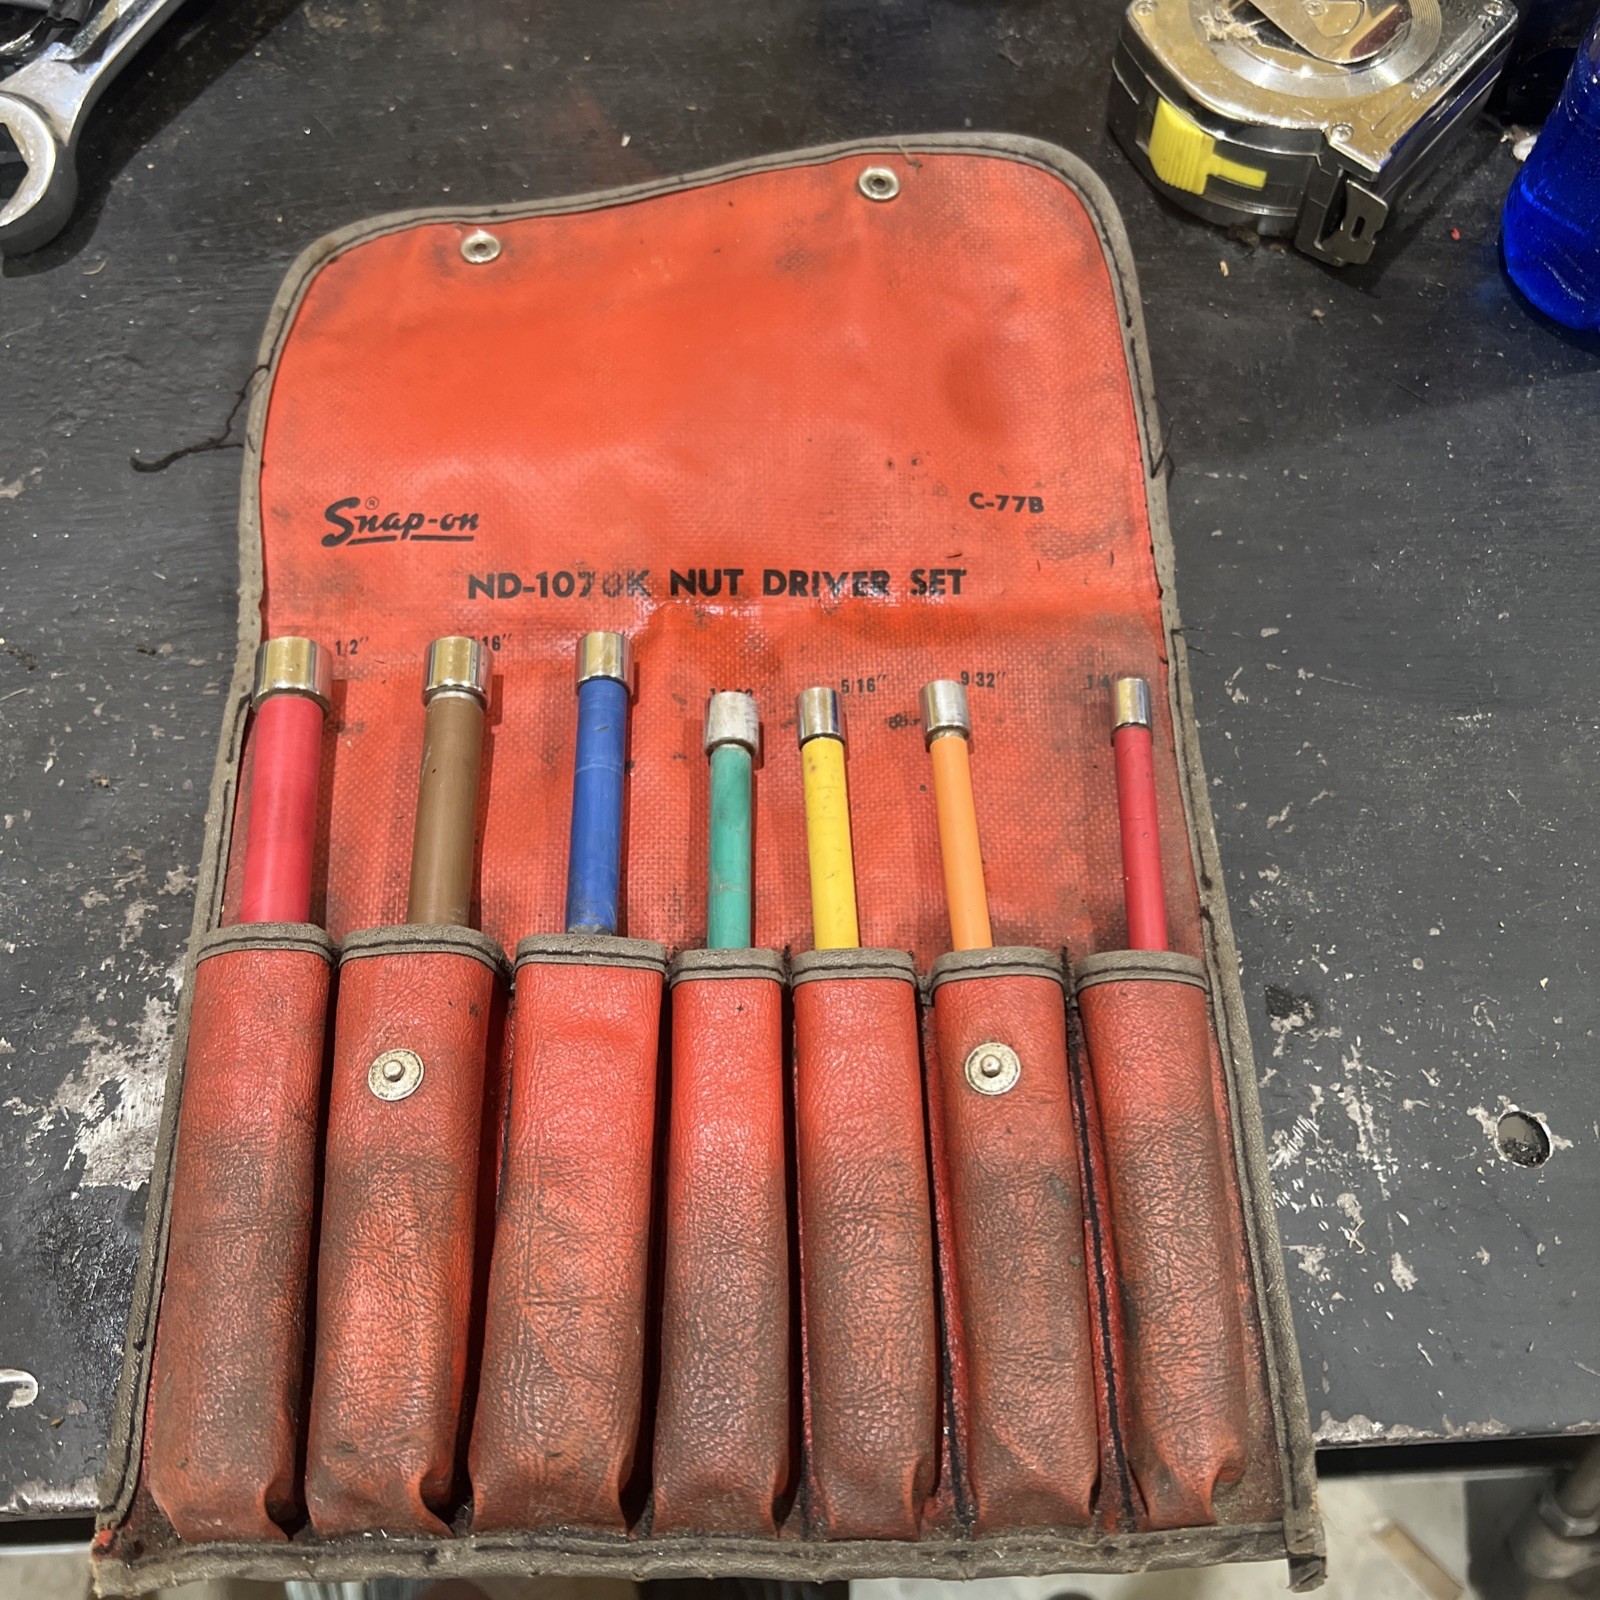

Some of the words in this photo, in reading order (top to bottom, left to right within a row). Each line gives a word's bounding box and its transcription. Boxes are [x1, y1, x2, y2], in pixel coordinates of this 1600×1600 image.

[969, 492, 1045, 514] C-77B
[467, 570, 652, 600] ND-1070K
[670, 568, 744, 597] NUT
[763, 568, 891, 597] DRIVER
[911, 568, 967, 596] SET
